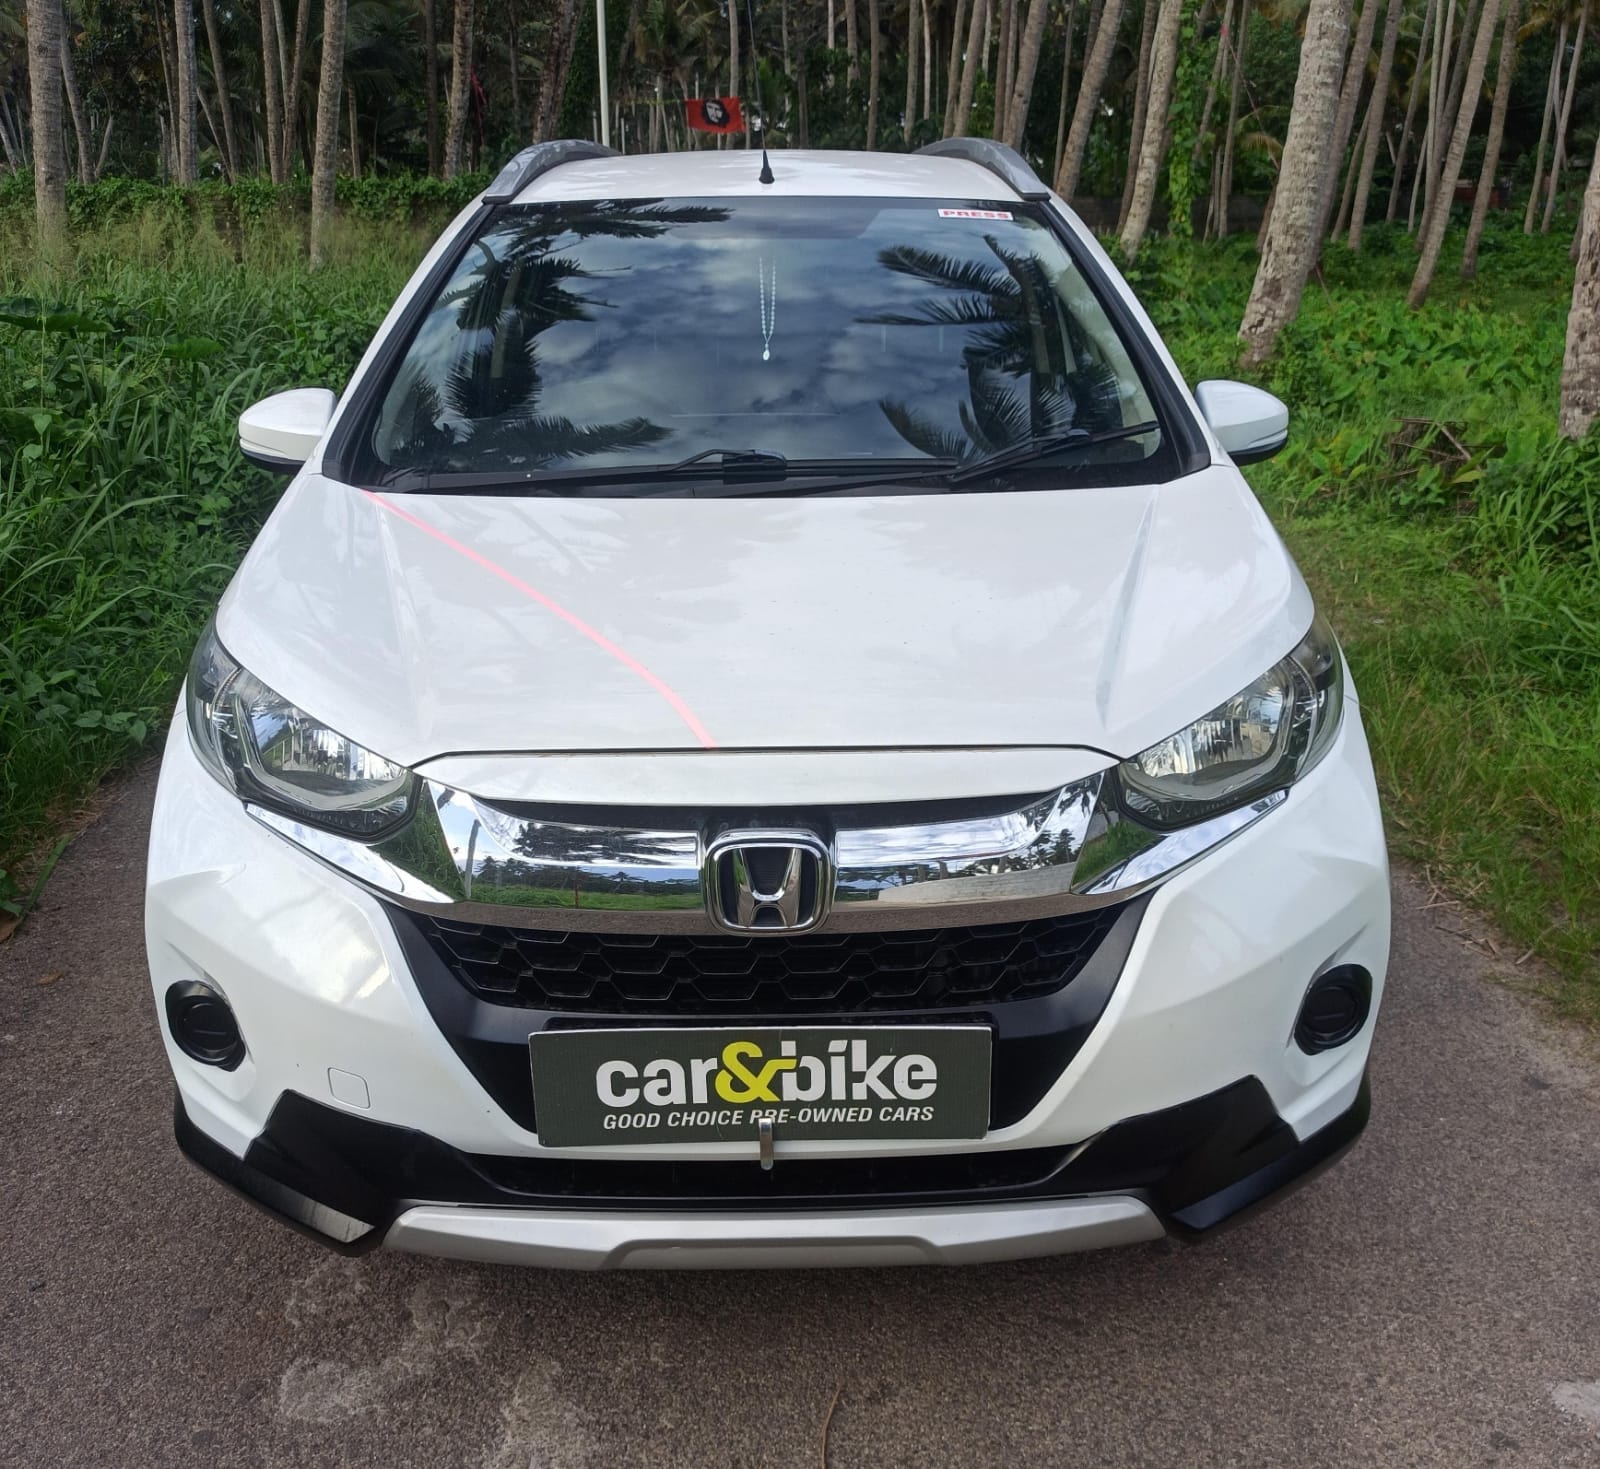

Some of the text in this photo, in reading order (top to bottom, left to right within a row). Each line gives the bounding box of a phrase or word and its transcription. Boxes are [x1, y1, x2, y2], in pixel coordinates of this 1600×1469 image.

[942, 210, 1009, 219] PRESS
[596, 1039, 938, 1107] car&bike
[603, 1106, 935, 1130] GOOD CHOICE PRE-OWNED CARS
